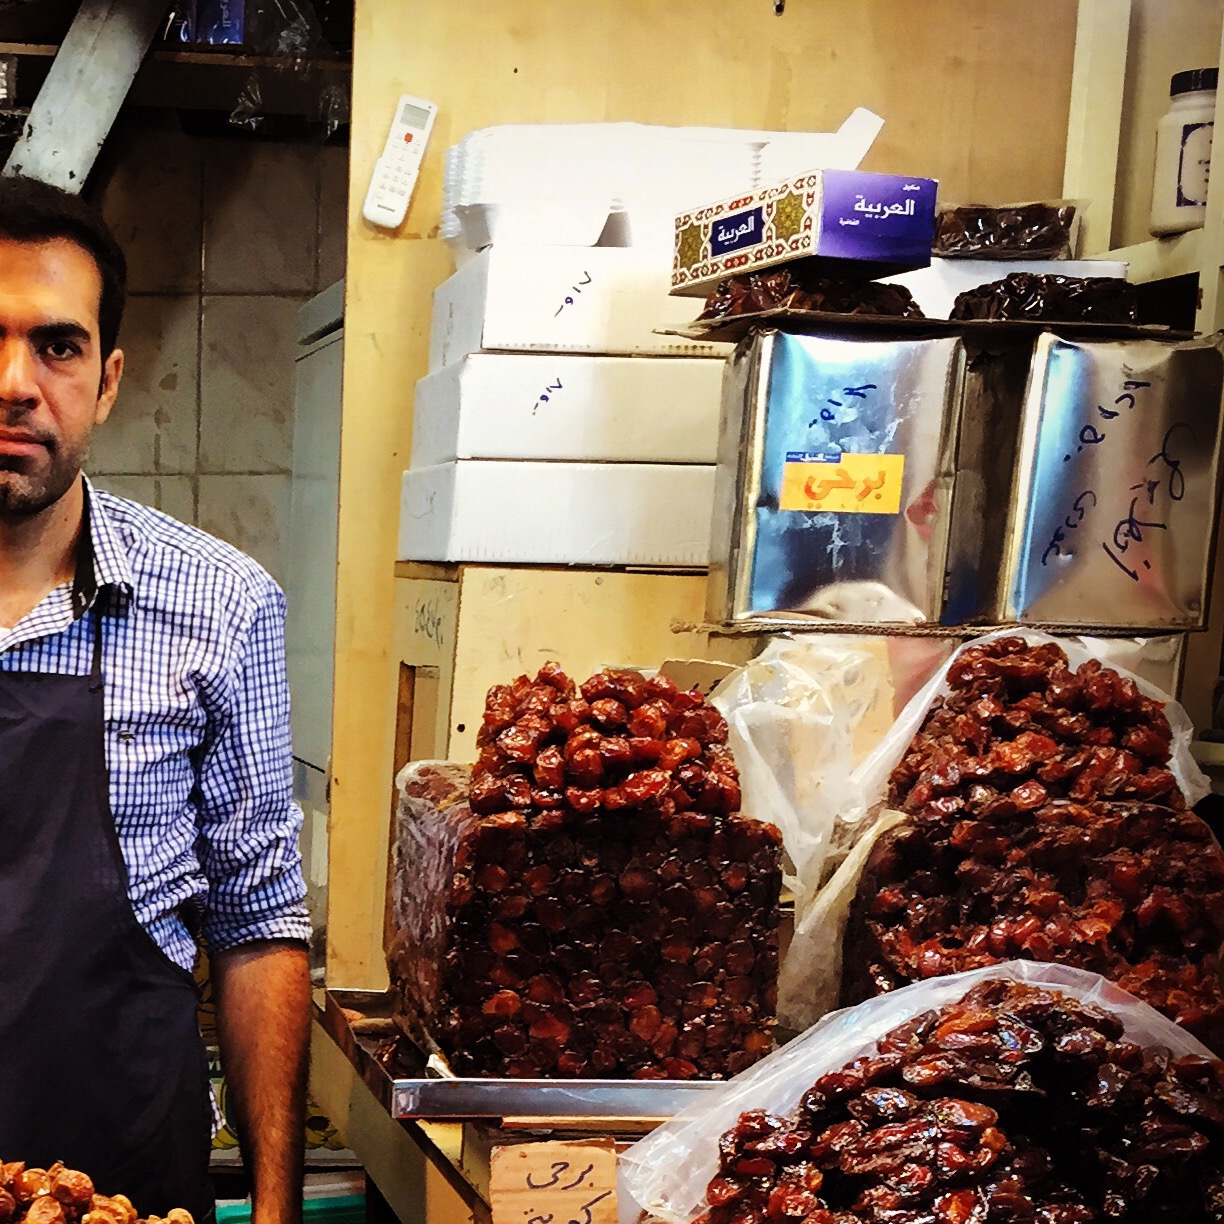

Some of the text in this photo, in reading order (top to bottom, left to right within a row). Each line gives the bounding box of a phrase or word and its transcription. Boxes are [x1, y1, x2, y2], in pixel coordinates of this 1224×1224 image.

[853, 194, 916, 219] العربية
[717, 214, 755, 245] العربية
[804, 467, 886, 510] برحي
